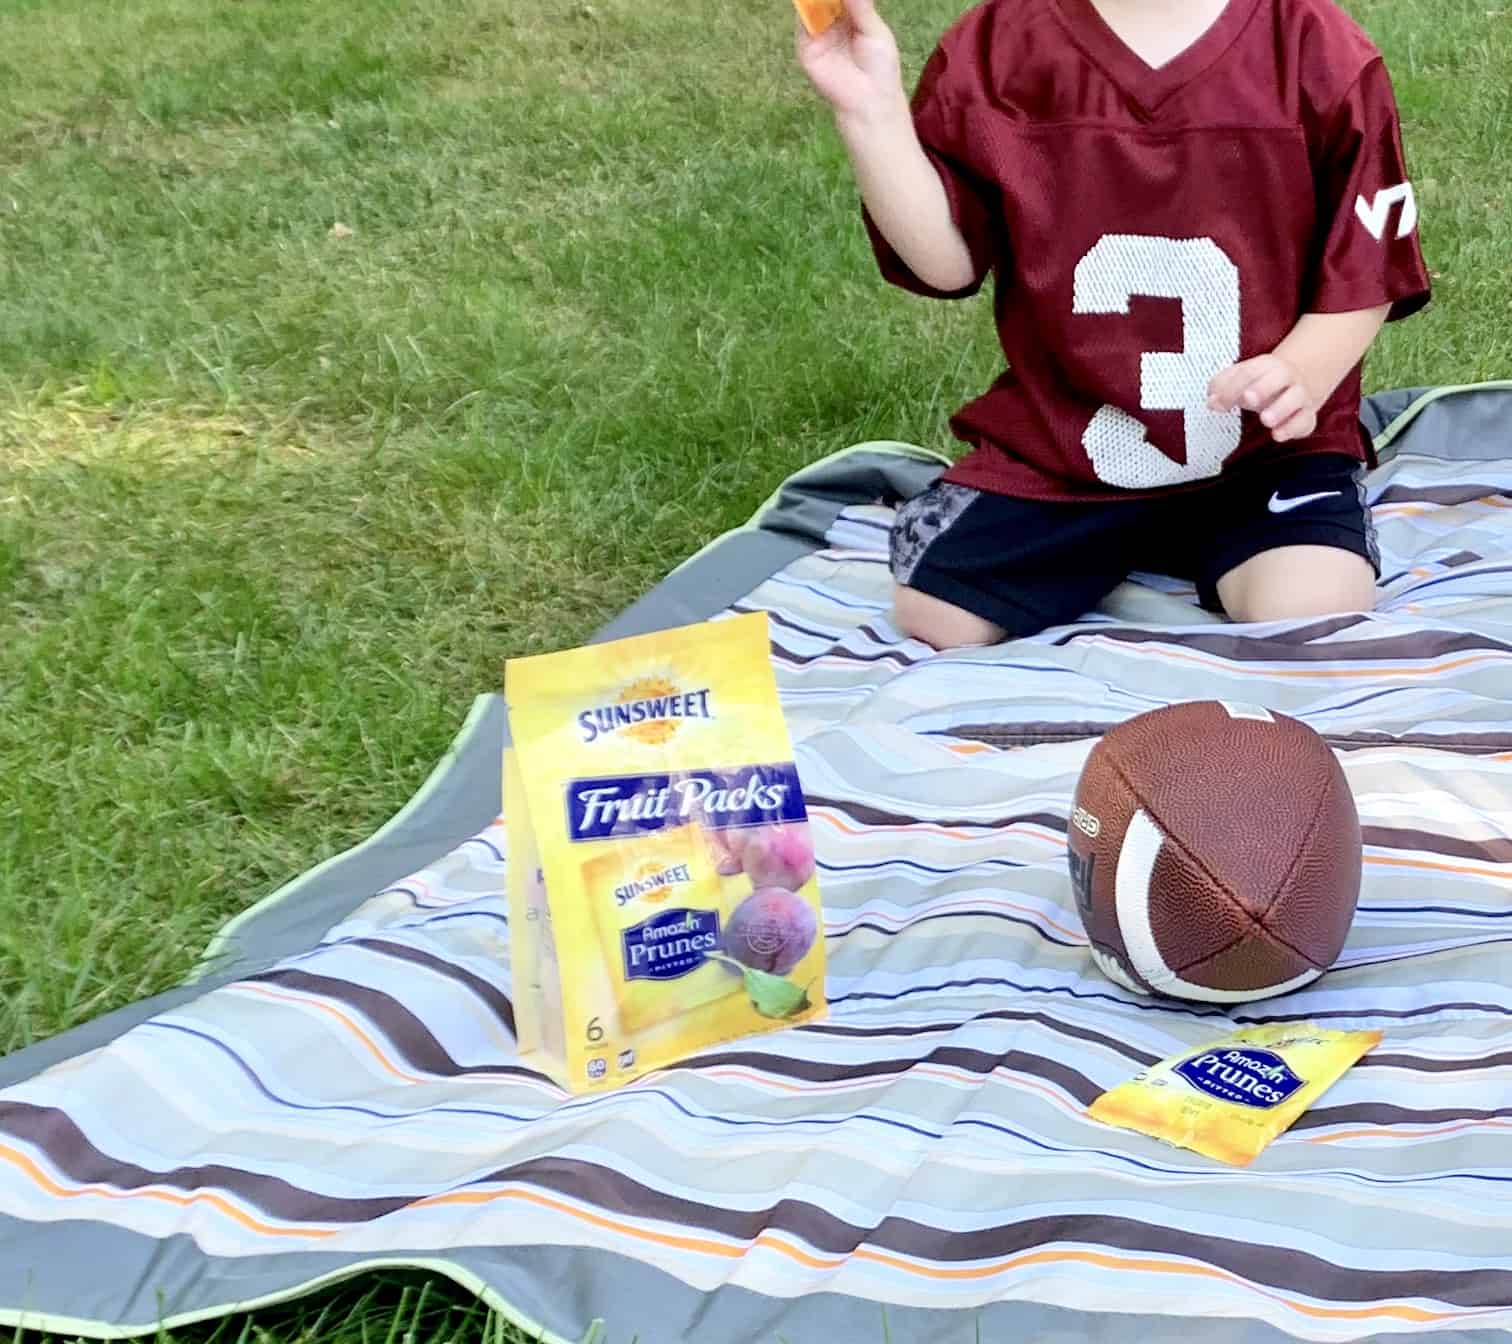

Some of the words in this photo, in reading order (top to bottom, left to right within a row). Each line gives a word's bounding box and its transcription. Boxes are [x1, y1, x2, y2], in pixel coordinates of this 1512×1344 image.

[1072, 233, 1242, 490] 3
[578, 689, 710, 742] SUNSWEET
[578, 786, 671, 831] Fruit
[674, 773, 789, 818] Packs
[614, 863, 691, 907] SUNSWEET
[630, 932, 717, 966] Prunes
[586, 1016, 604, 1042] 6
[1190, 1053, 1284, 1104] Prunes
